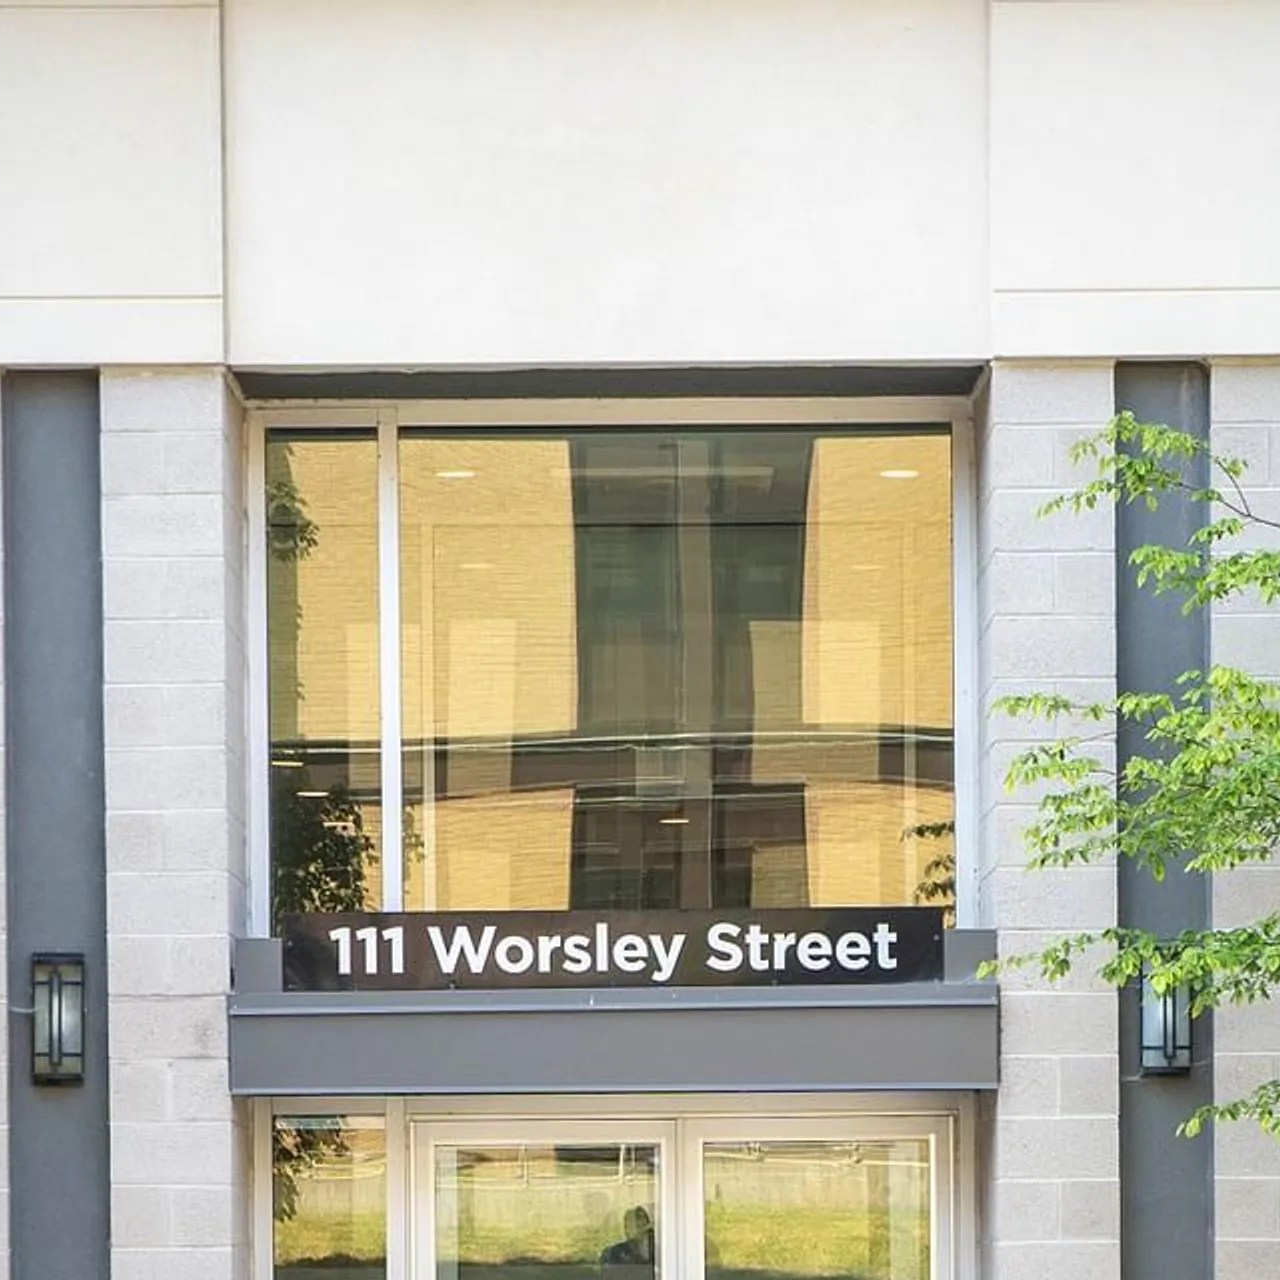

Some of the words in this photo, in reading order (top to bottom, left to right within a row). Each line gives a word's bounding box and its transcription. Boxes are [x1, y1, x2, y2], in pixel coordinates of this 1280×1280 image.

[330, 926, 405, 974] 111
[428, 924, 685, 982] Worsley
[706, 922, 898, 970] Street
